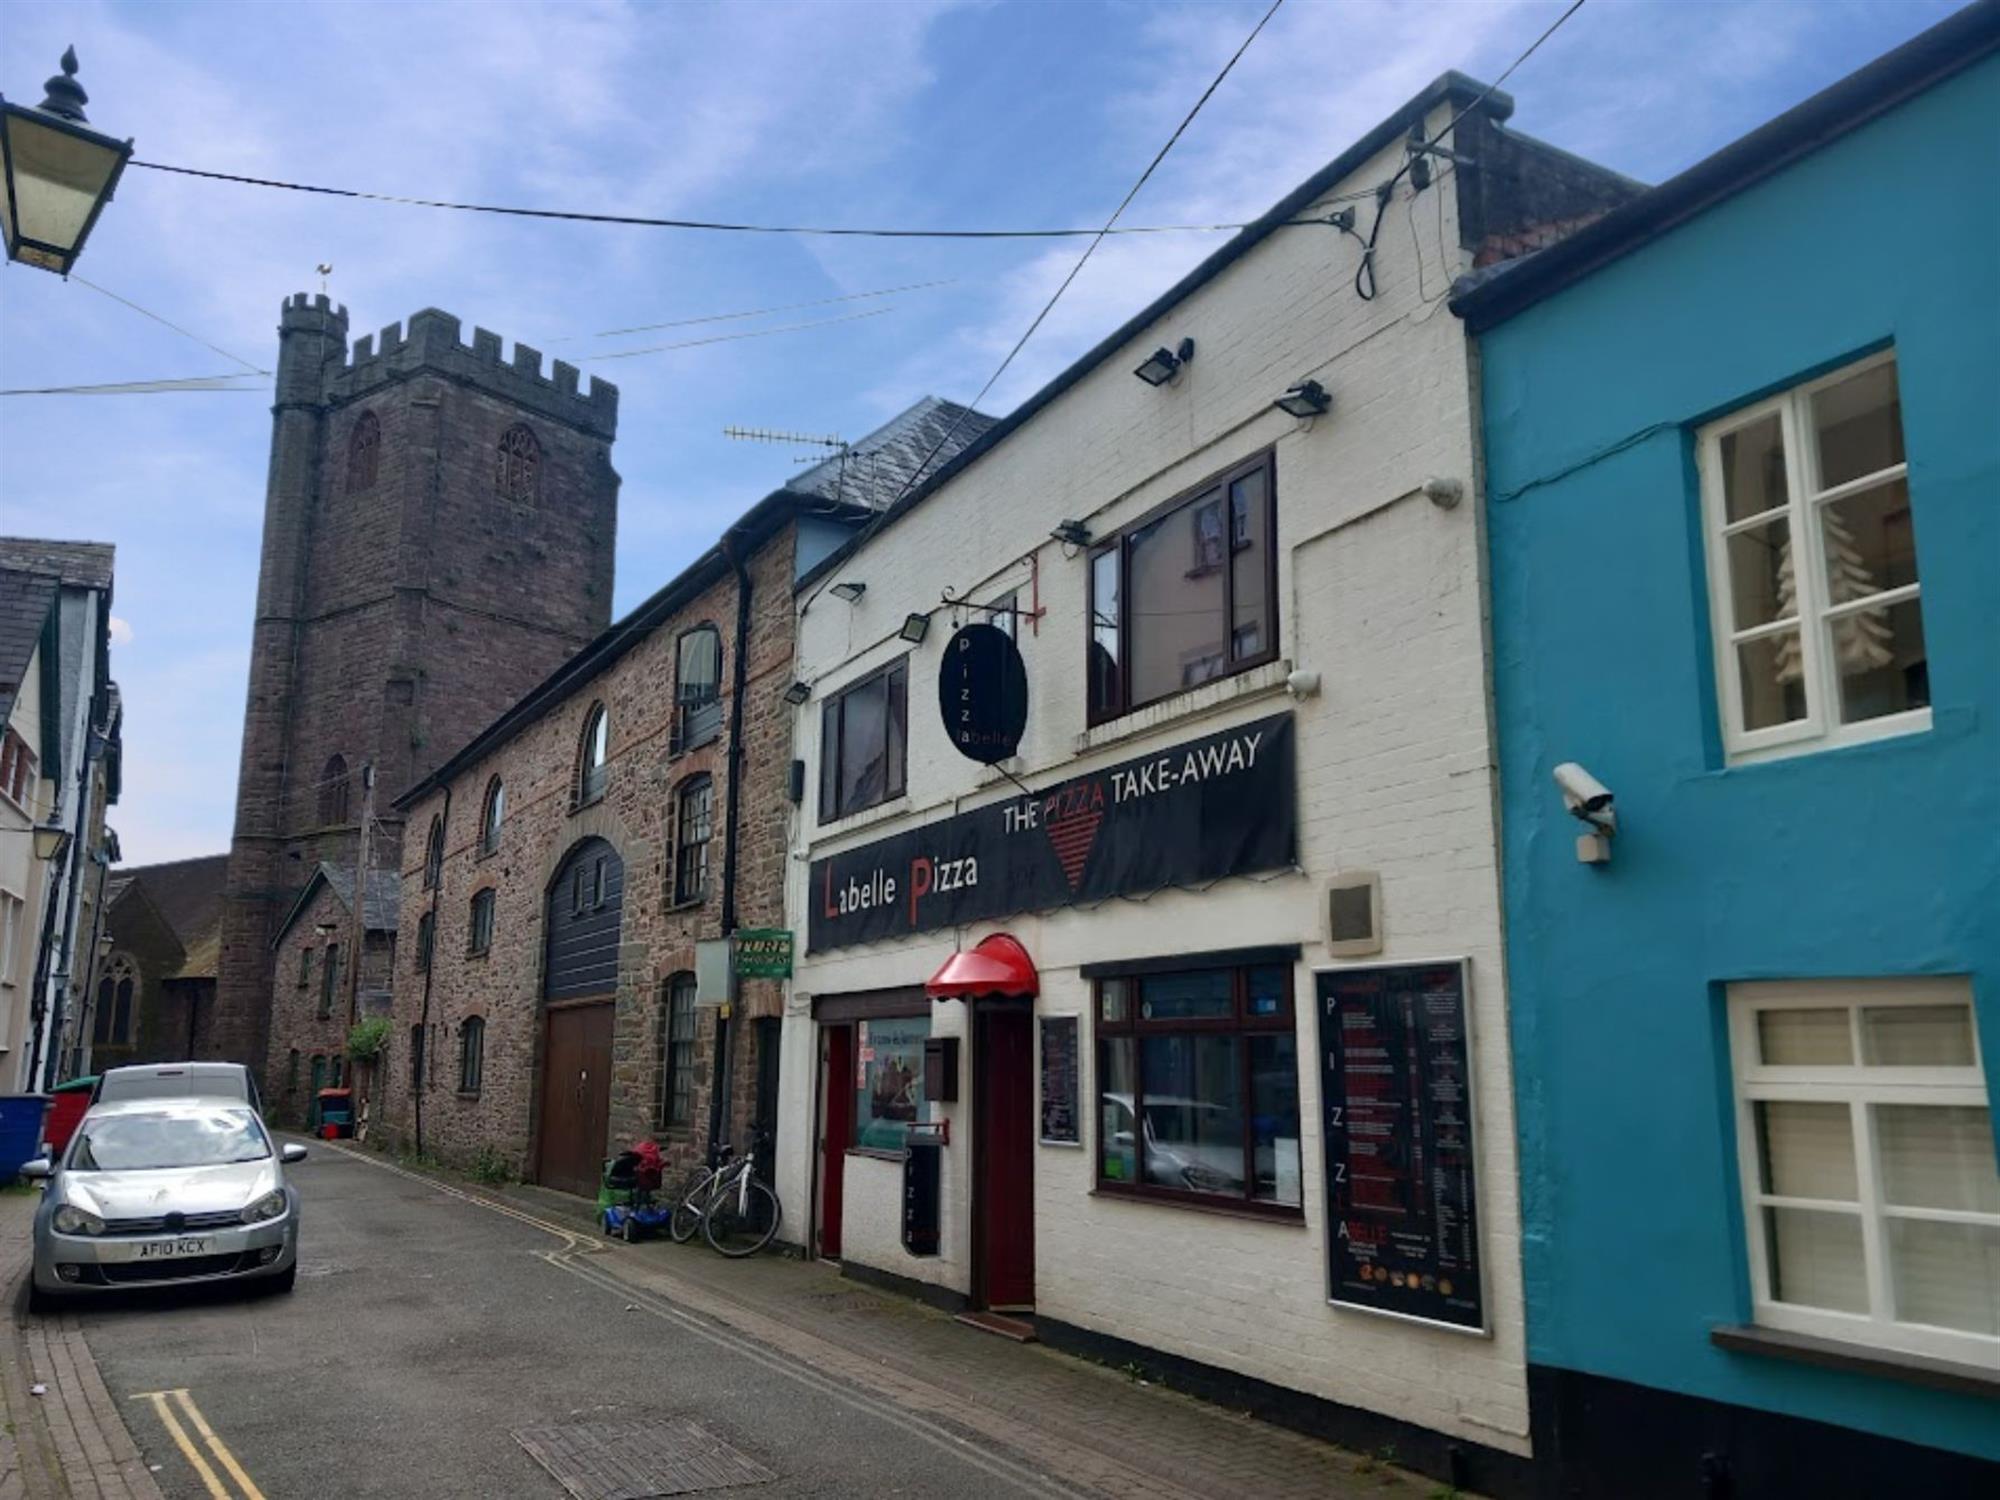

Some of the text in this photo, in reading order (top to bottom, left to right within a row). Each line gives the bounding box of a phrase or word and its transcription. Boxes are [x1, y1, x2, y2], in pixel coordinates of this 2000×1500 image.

[1003, 732, 1263, 835] THE PIZZA TAKE-AWAY
[825, 855, 978, 926] Labelle Pizza
[140, 1239, 205, 1257] AF10 KCX
